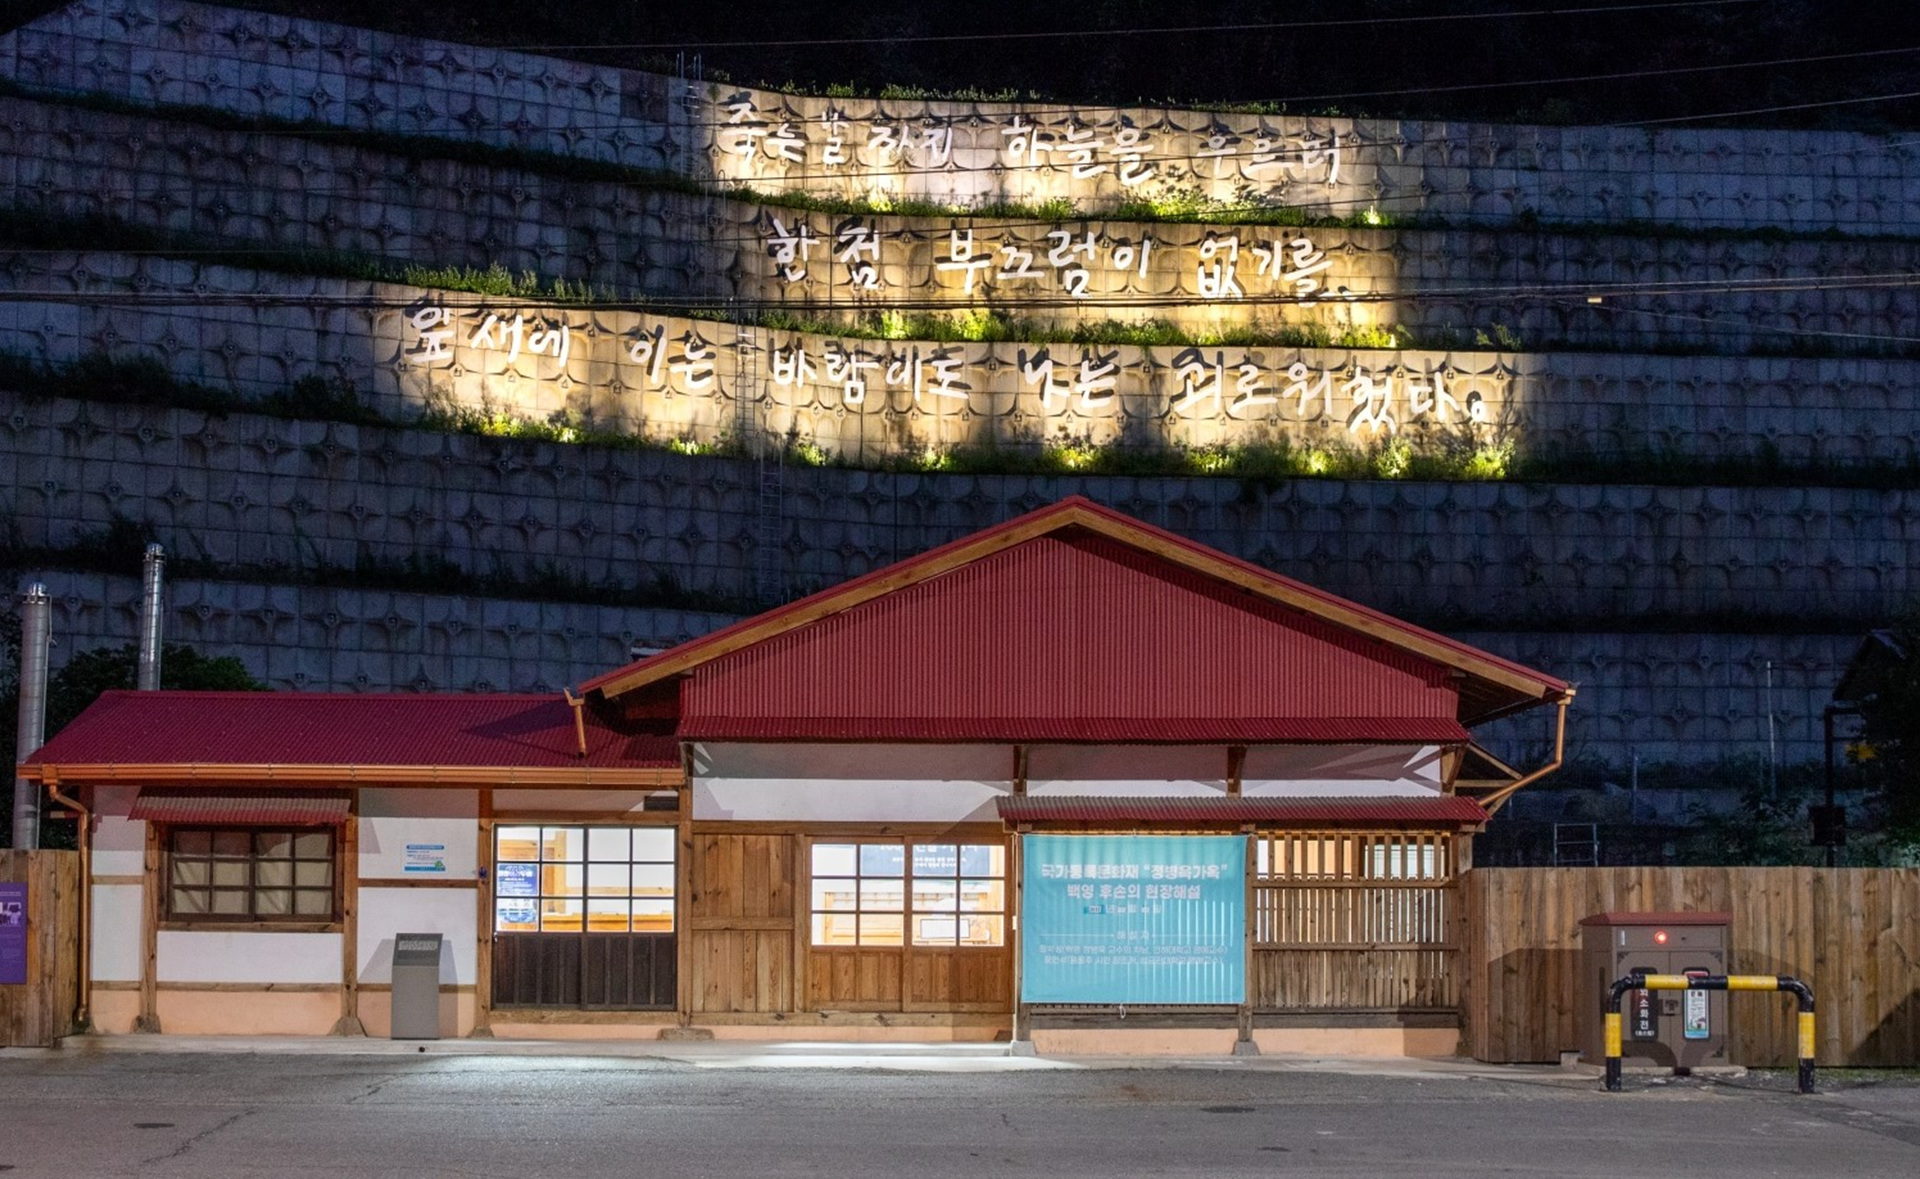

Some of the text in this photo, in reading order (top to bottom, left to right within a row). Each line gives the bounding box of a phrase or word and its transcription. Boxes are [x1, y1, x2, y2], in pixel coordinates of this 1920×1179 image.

[1002, 114, 1155, 185] 하늘을
[1197, 135, 1341, 184] 우르러
[936, 228, 1150, 297] 부끄럼이
[411, 306, 570, 368] 잎새에
[630, 333, 714, 389] 이는
[773, 350, 969, 405] 바람에도
[1025, 359, 1116, 409] 나는
[1041, 863, 1139, 880] 국가등록문화재
[1066, 883, 1201, 899] 백영 후손의 현장해설
